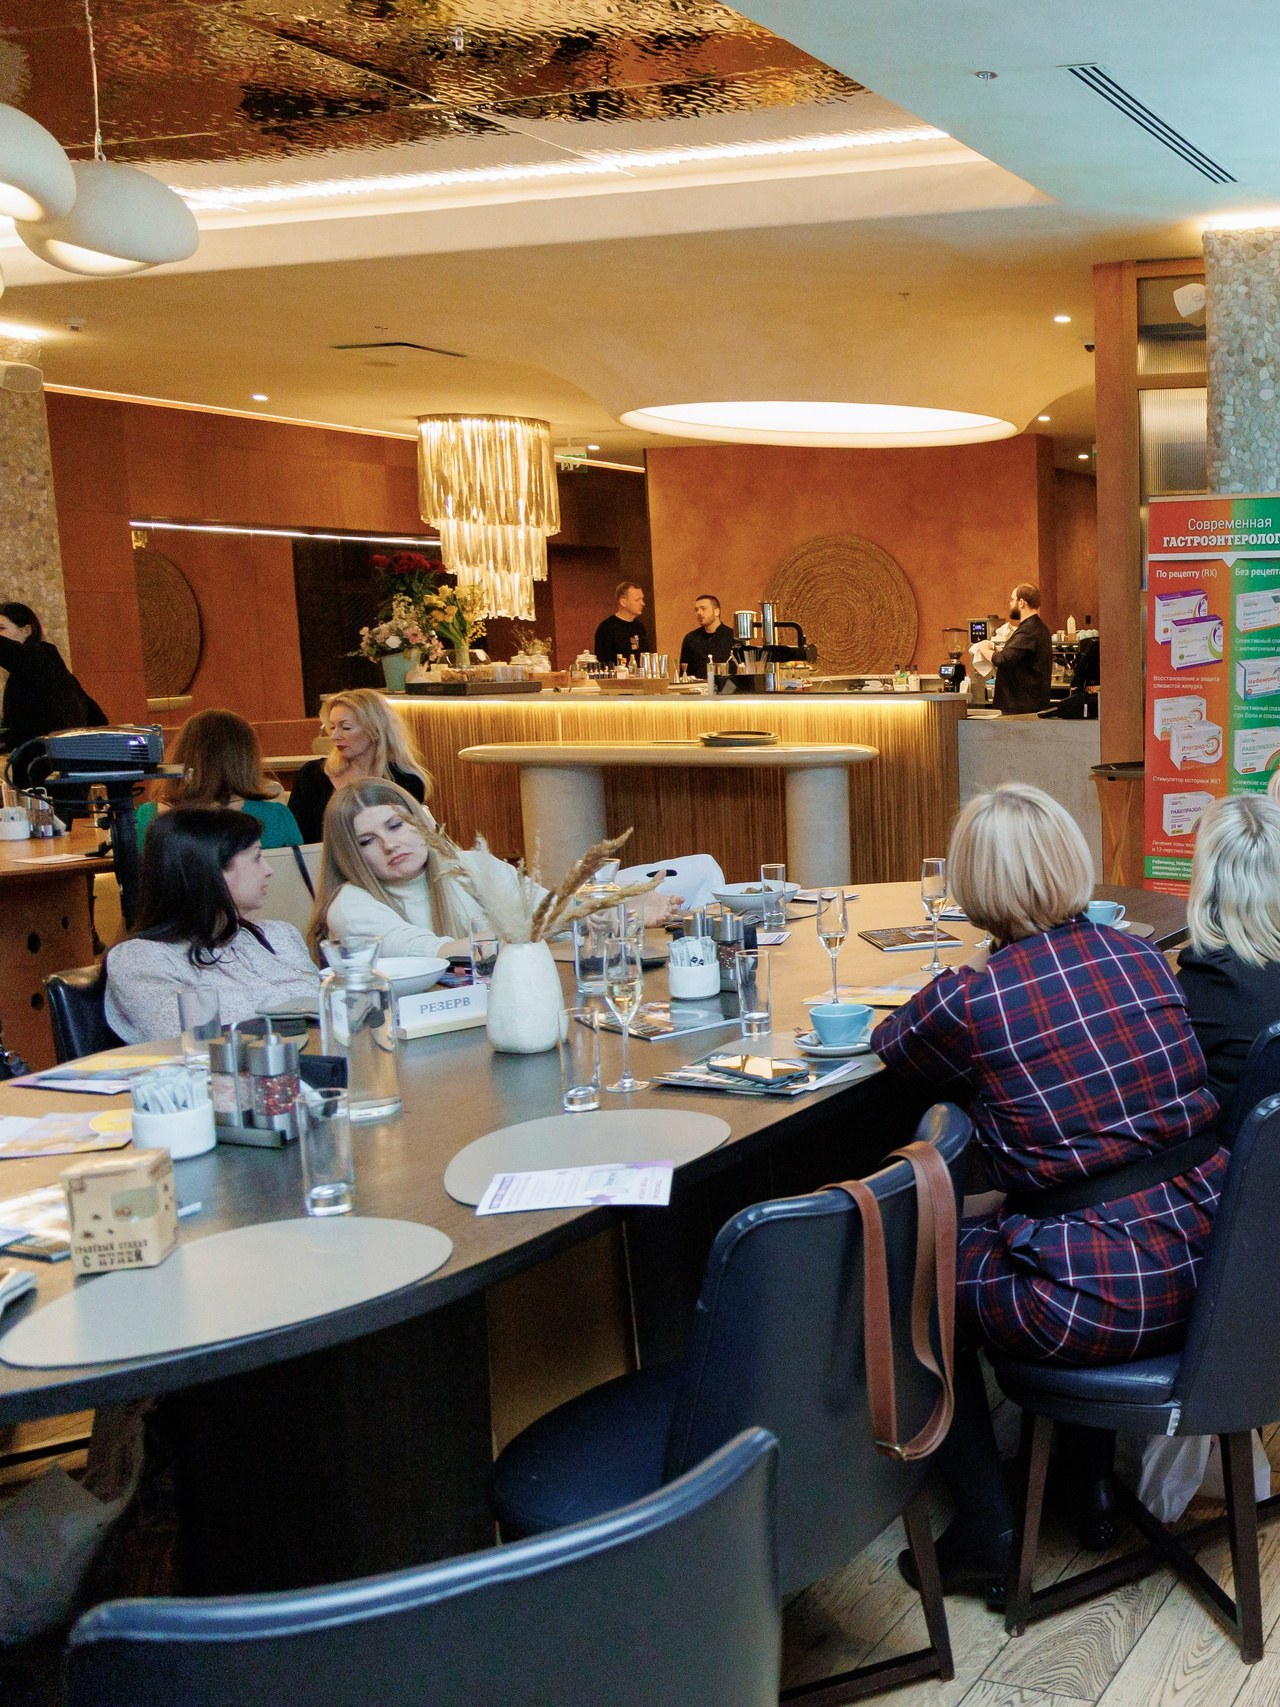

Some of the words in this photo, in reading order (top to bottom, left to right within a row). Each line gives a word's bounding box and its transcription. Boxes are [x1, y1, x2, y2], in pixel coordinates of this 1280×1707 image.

[1188, 518, 1272, 533] Современная
[1156, 569, 1167, 578] По
[1168, 569, 1200, 581] рецепту
[1201, 567, 1217, 579] (RX)
[1235, 568, 1249, 576] Без
[1152, 775, 1184, 784] Стимулятор
[419, 996, 471, 1015] РЕЗЕРВ
[82, 1255, 91, 1268] С
